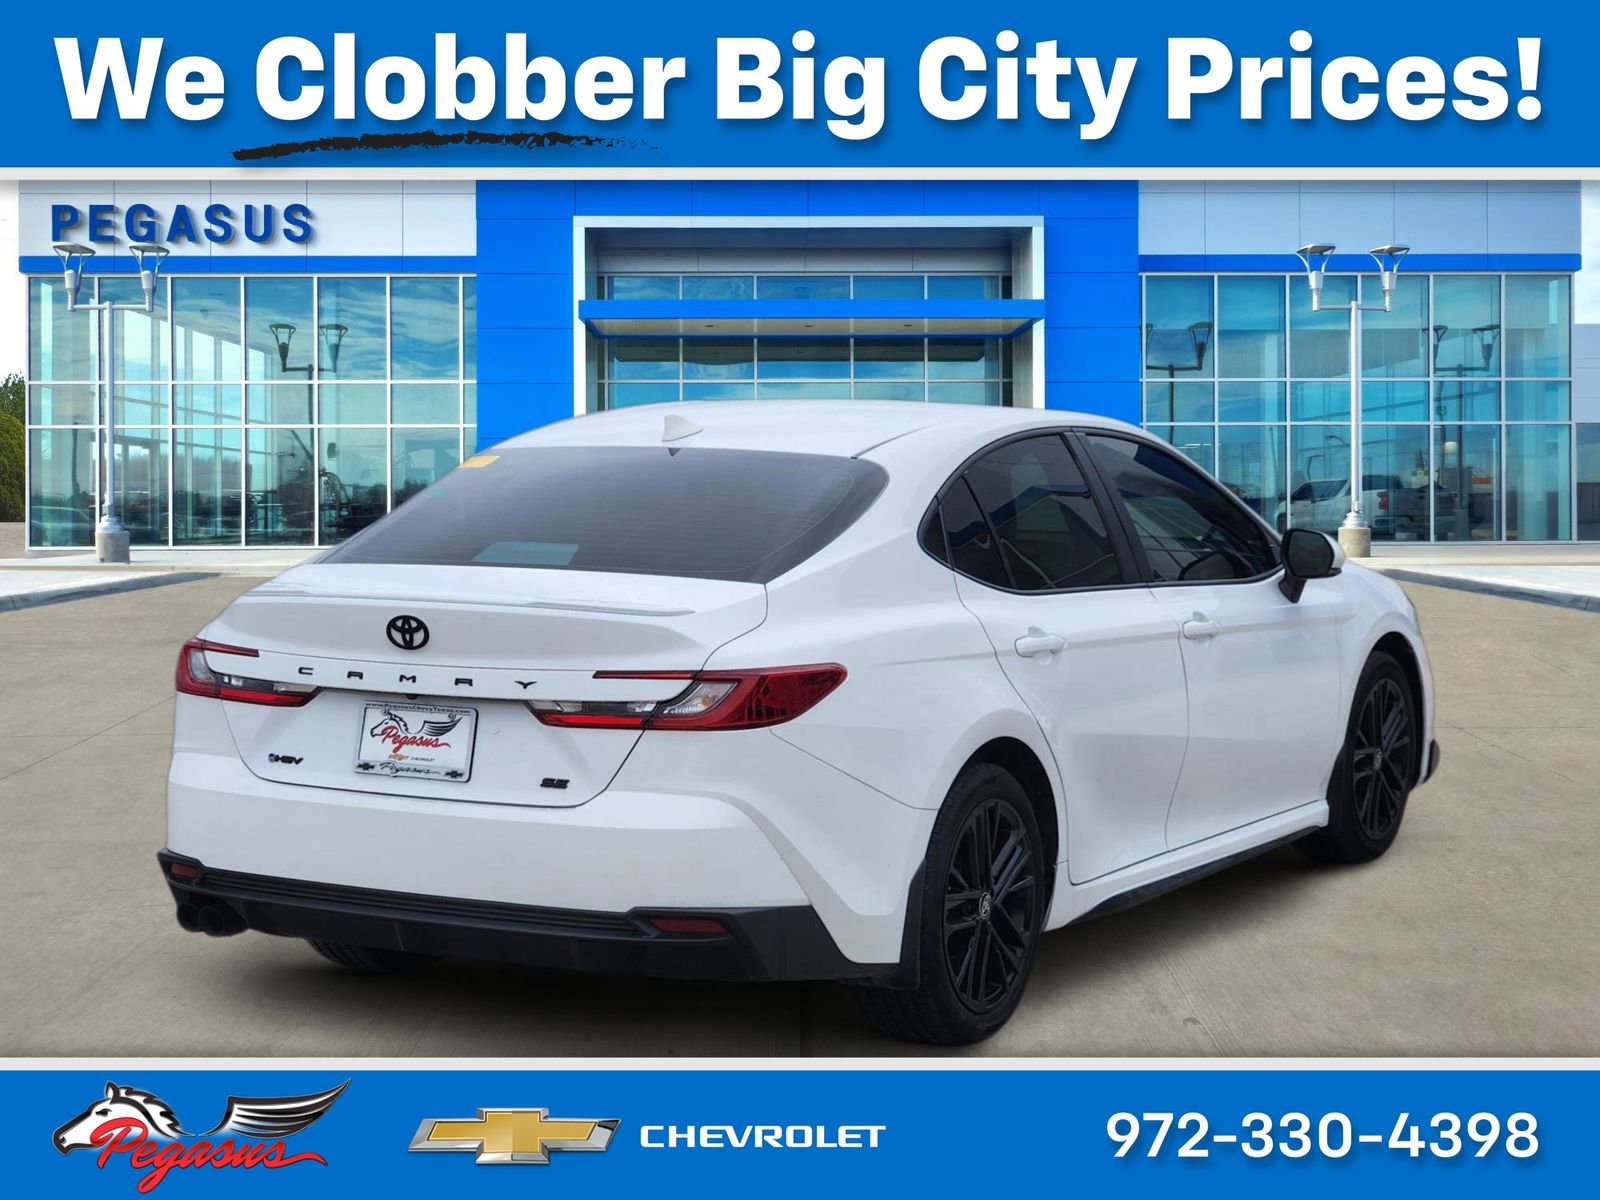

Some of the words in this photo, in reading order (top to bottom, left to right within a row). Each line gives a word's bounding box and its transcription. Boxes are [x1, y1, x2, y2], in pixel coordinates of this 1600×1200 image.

[51, 203, 315, 244] PEGASUS
[298, 666, 538, 690] CAMRY
[380, 725, 451, 753] Pegasus
